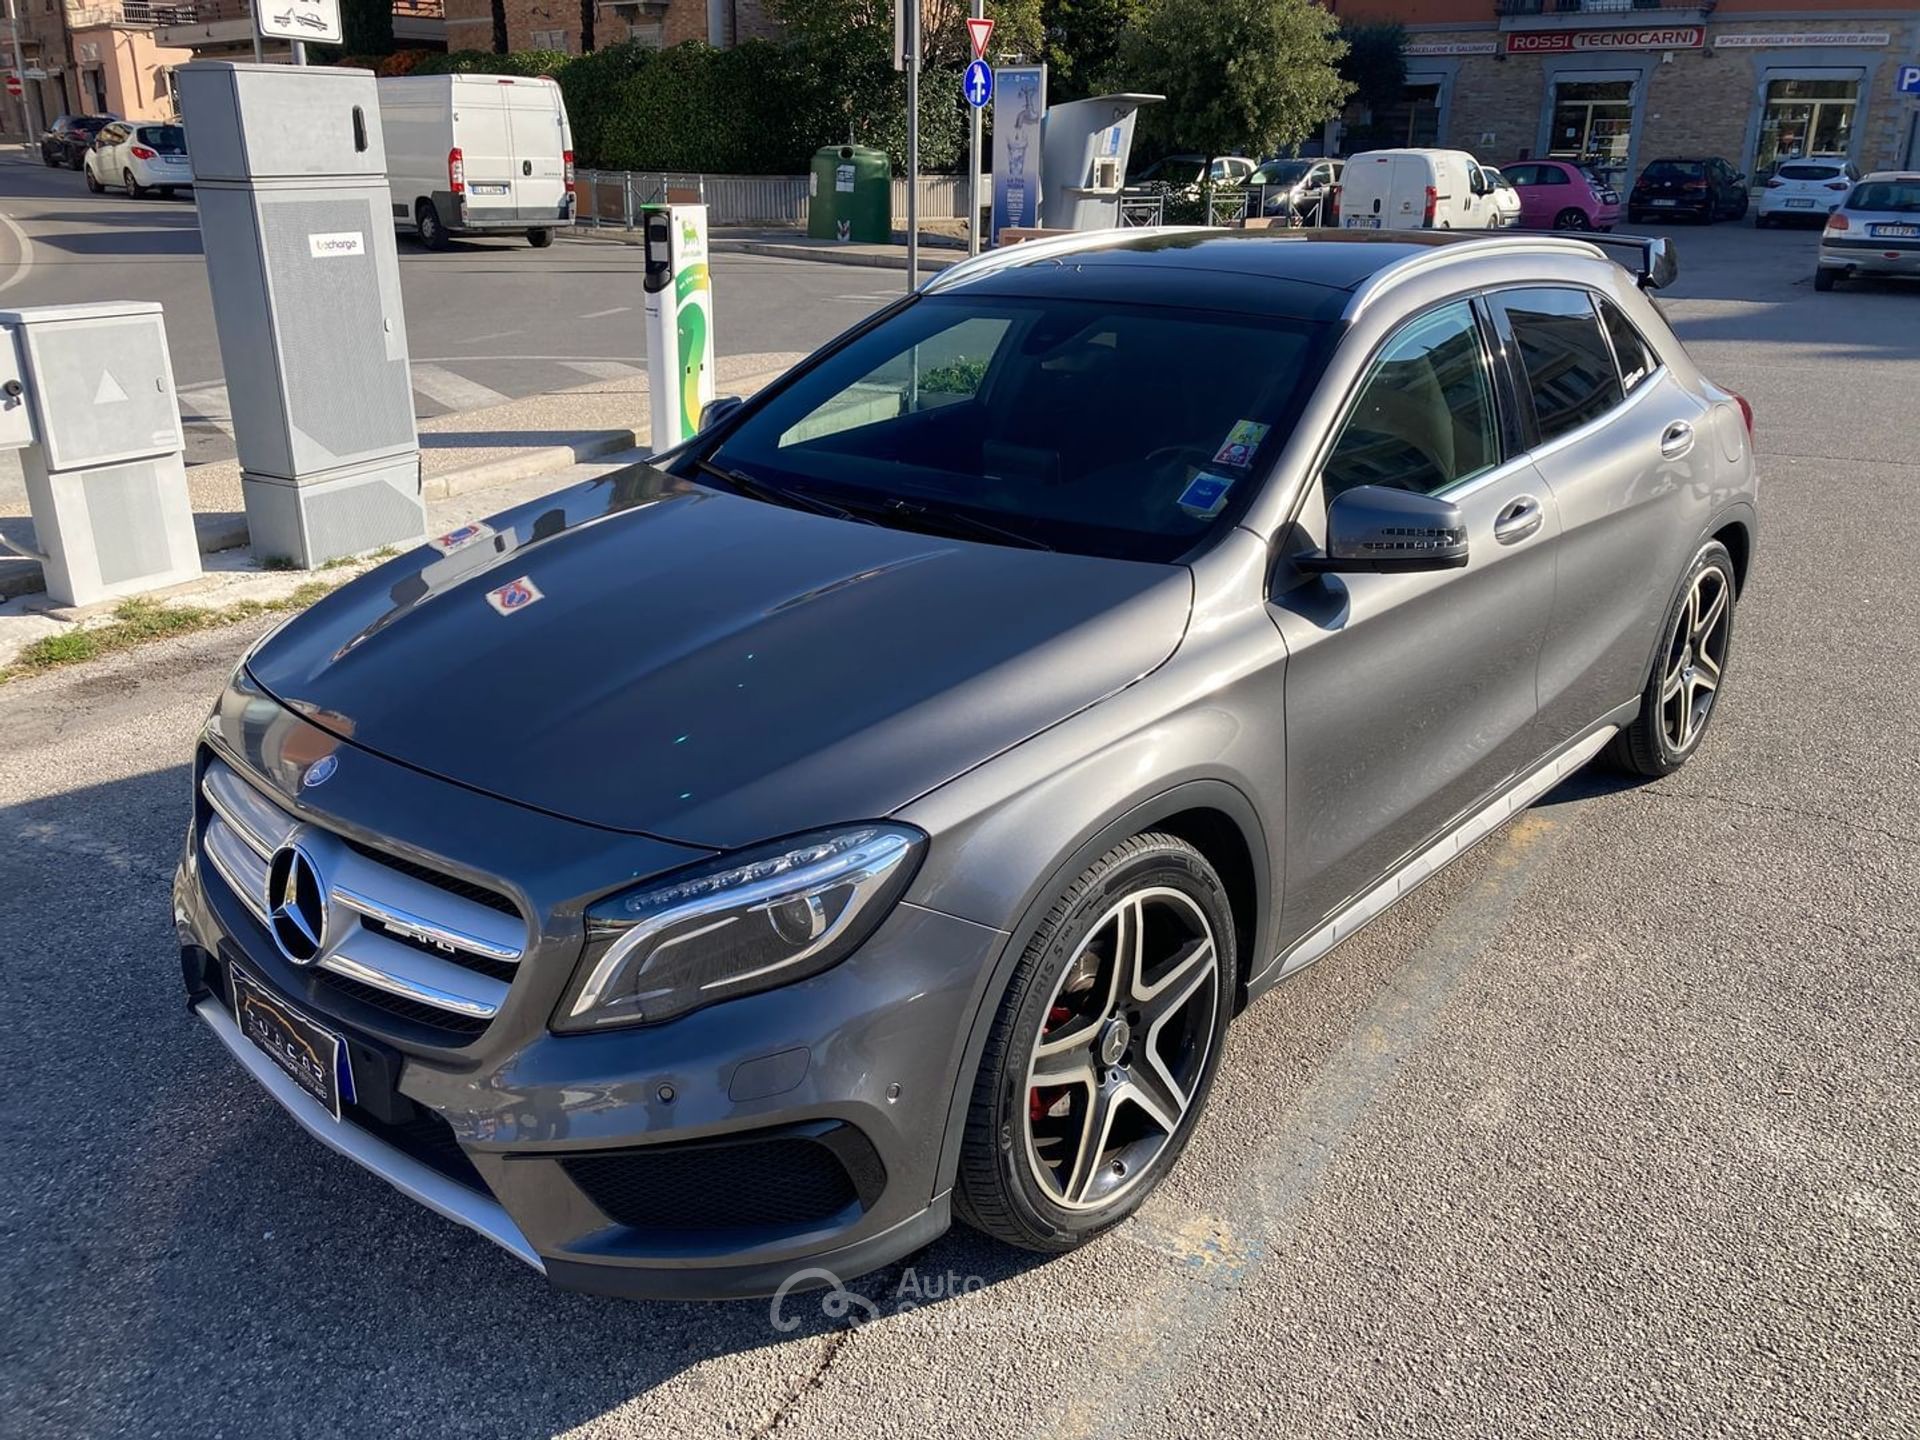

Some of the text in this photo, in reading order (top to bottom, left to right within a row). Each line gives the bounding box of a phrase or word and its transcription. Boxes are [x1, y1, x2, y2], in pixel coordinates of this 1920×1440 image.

[1513, 30, 1694, 49] ROSSI TECNOCARNI
[1902, 67, 1920, 91] P
